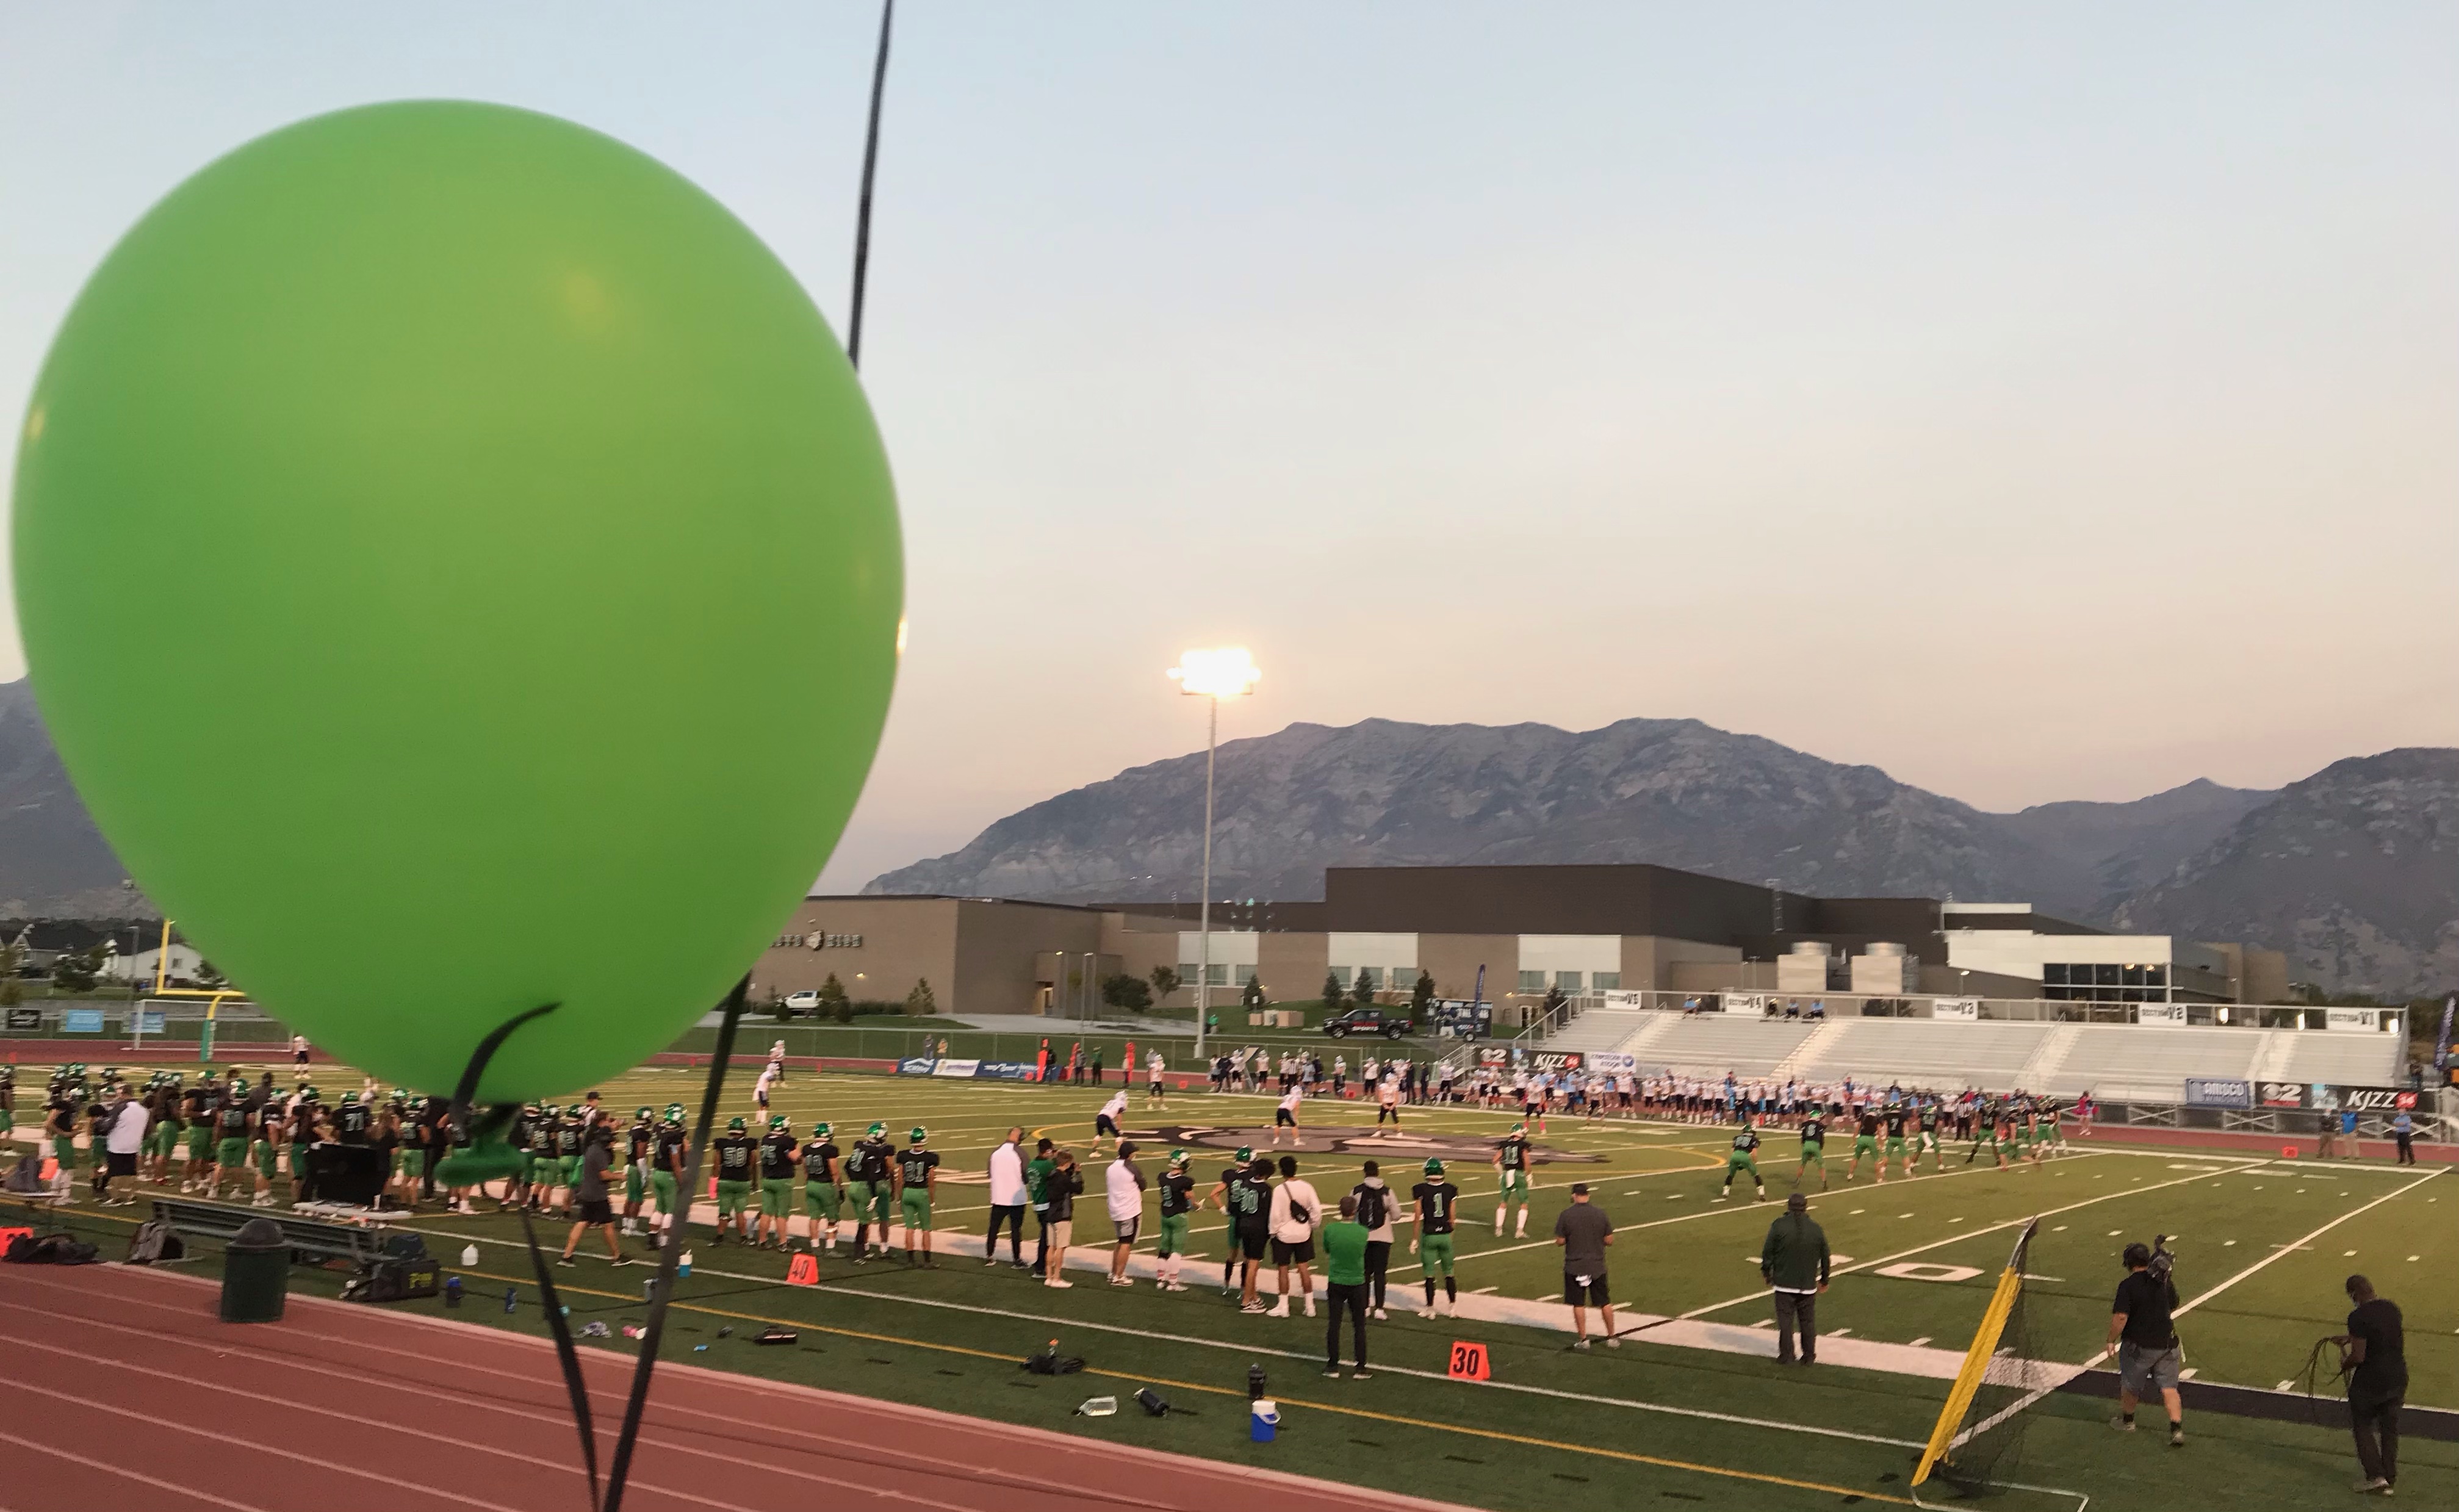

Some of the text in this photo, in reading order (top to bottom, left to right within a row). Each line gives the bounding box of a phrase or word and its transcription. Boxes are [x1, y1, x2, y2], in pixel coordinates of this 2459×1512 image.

[1533, 1054, 1569, 1071] KJZZ
[2346, 1090, 2399, 1112] KJZZ
[345, 1112, 364, 1131] 71
[722, 1147, 747, 1168] 58
[1433, 1192, 1444, 1218] 1
[791, 1258, 810, 1280] 40
[1453, 1347, 1479, 1377] 30
